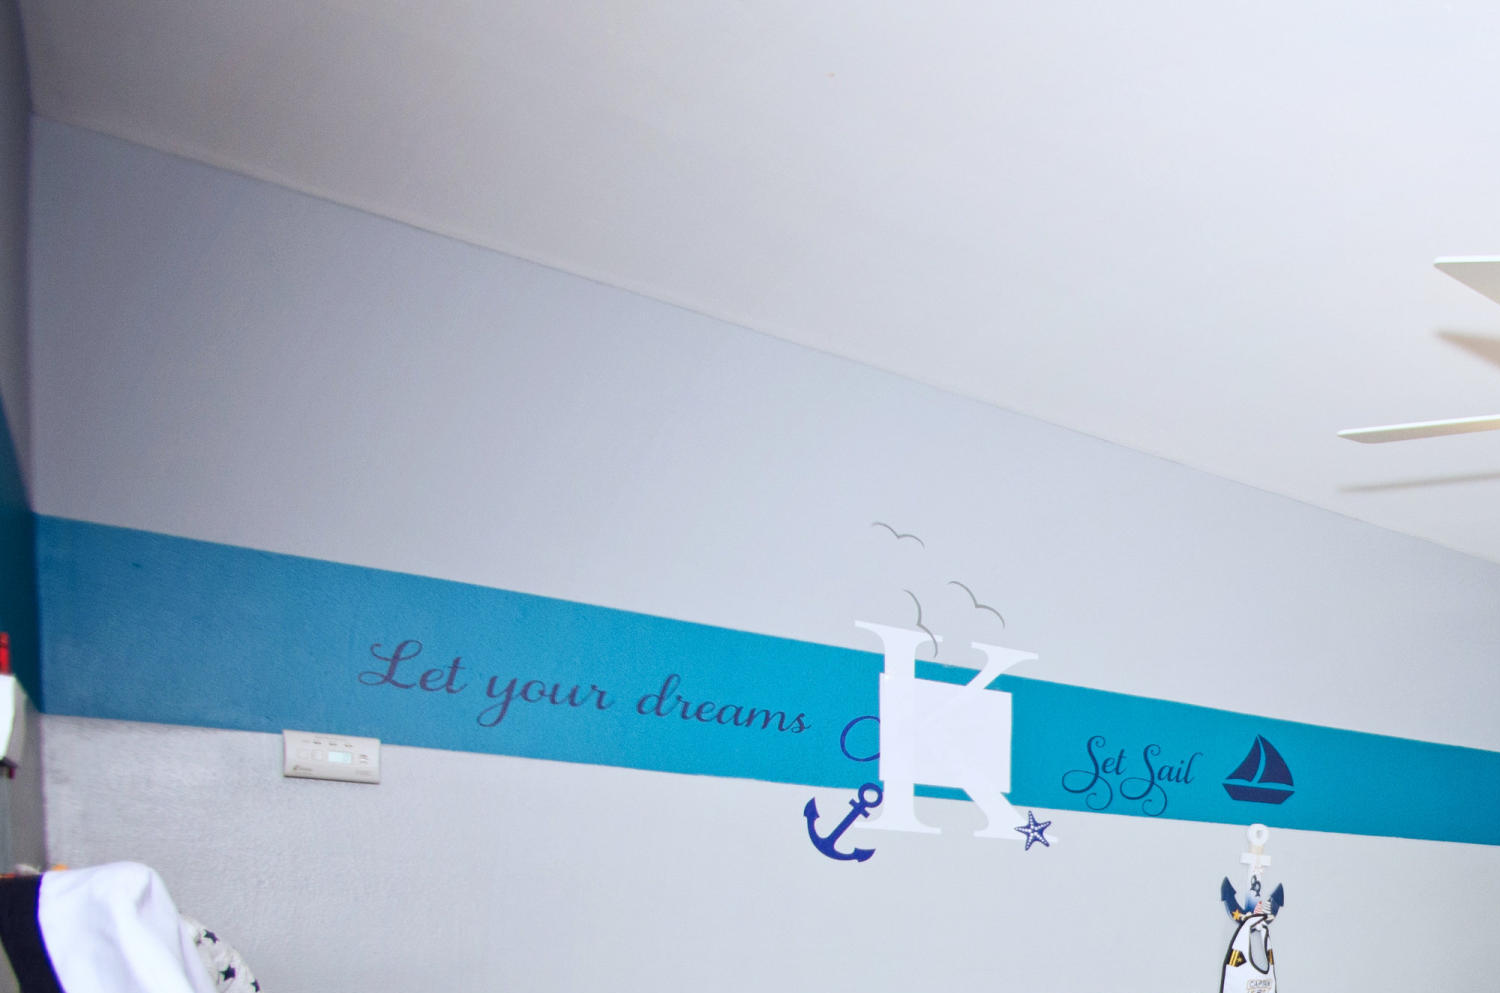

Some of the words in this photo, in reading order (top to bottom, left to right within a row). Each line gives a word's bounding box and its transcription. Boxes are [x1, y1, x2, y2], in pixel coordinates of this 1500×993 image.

[357, 639, 468, 694] Let
[476, 674, 615, 728] your
[636, 673, 812, 734] dreams
[854, 619, 1059, 844] K
[1062, 735, 1128, 811] Set
[1119, 743, 1204, 817] Sail
